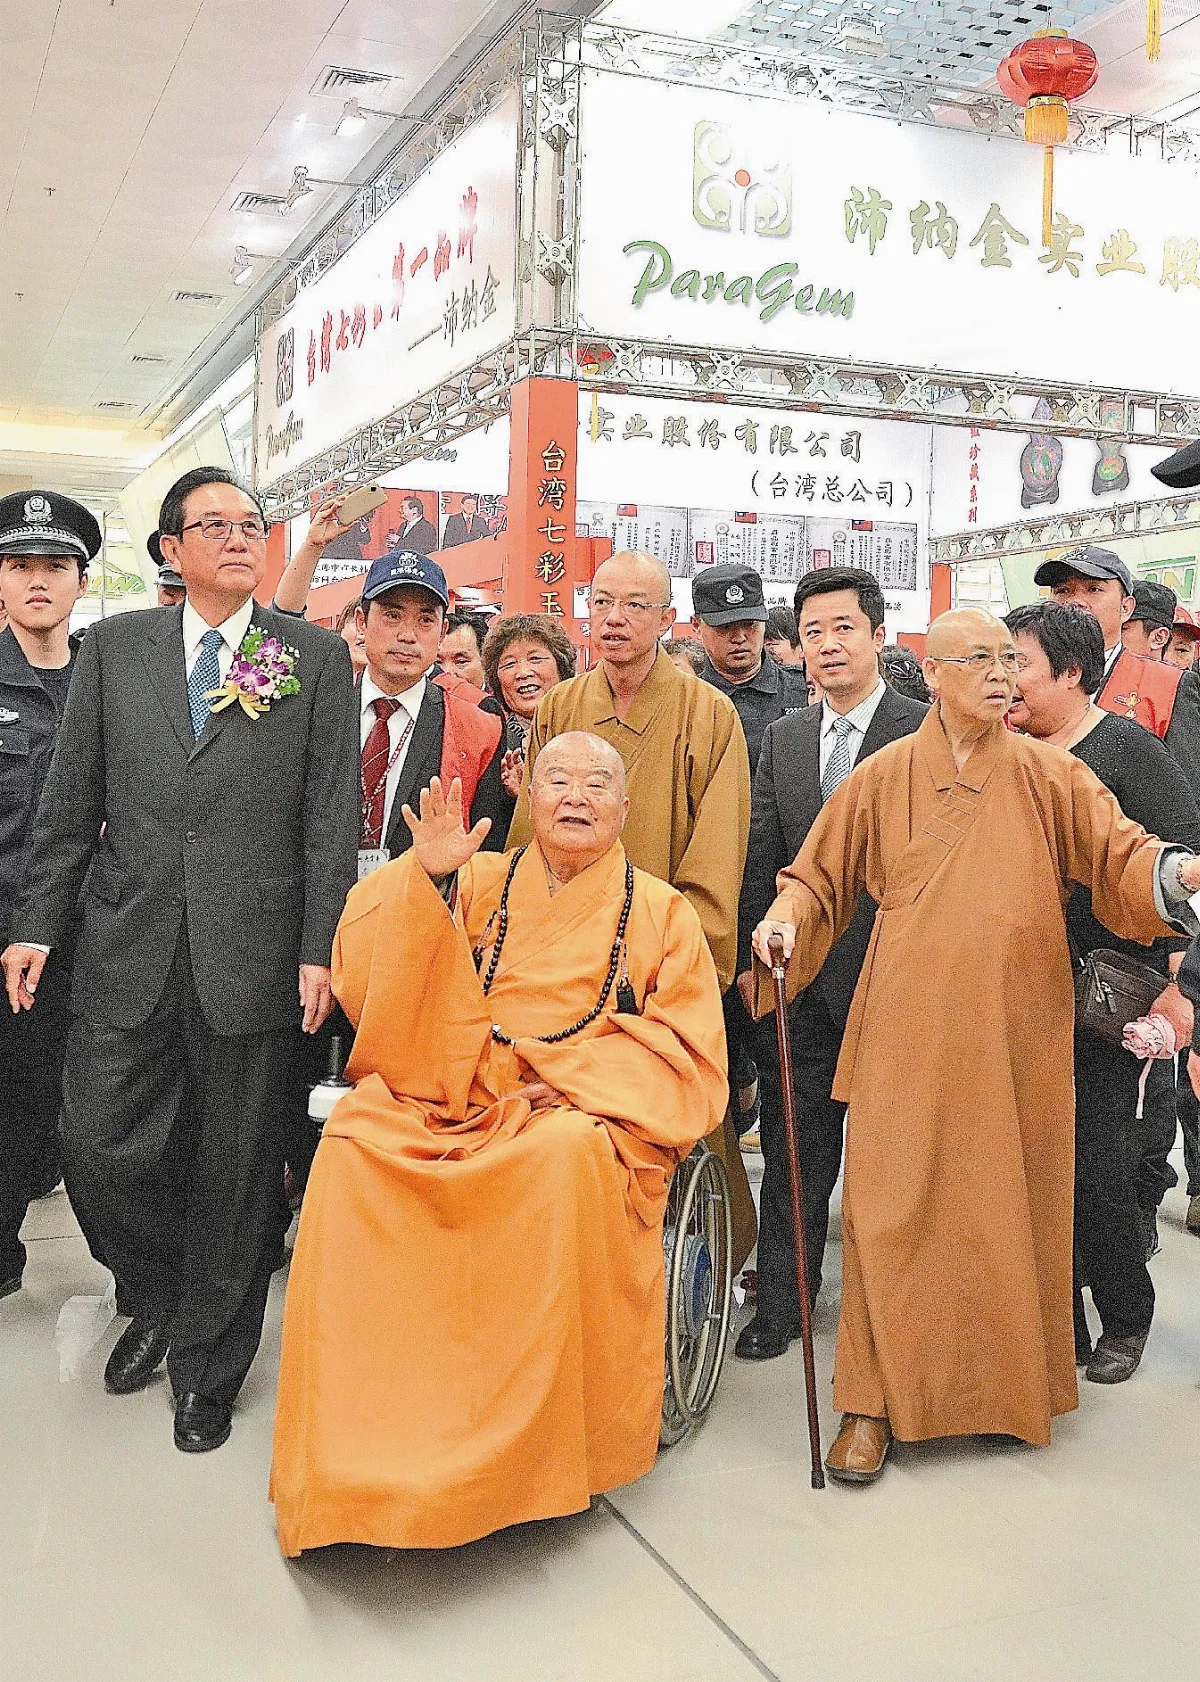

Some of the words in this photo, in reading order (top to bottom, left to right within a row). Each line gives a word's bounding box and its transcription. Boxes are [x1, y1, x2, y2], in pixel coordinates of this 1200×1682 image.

[623, 239, 856, 321] ParaGem
[586, 406, 863, 463] 实业股份有限公司
[535, 440, 567, 618] 台湾七彩玉
